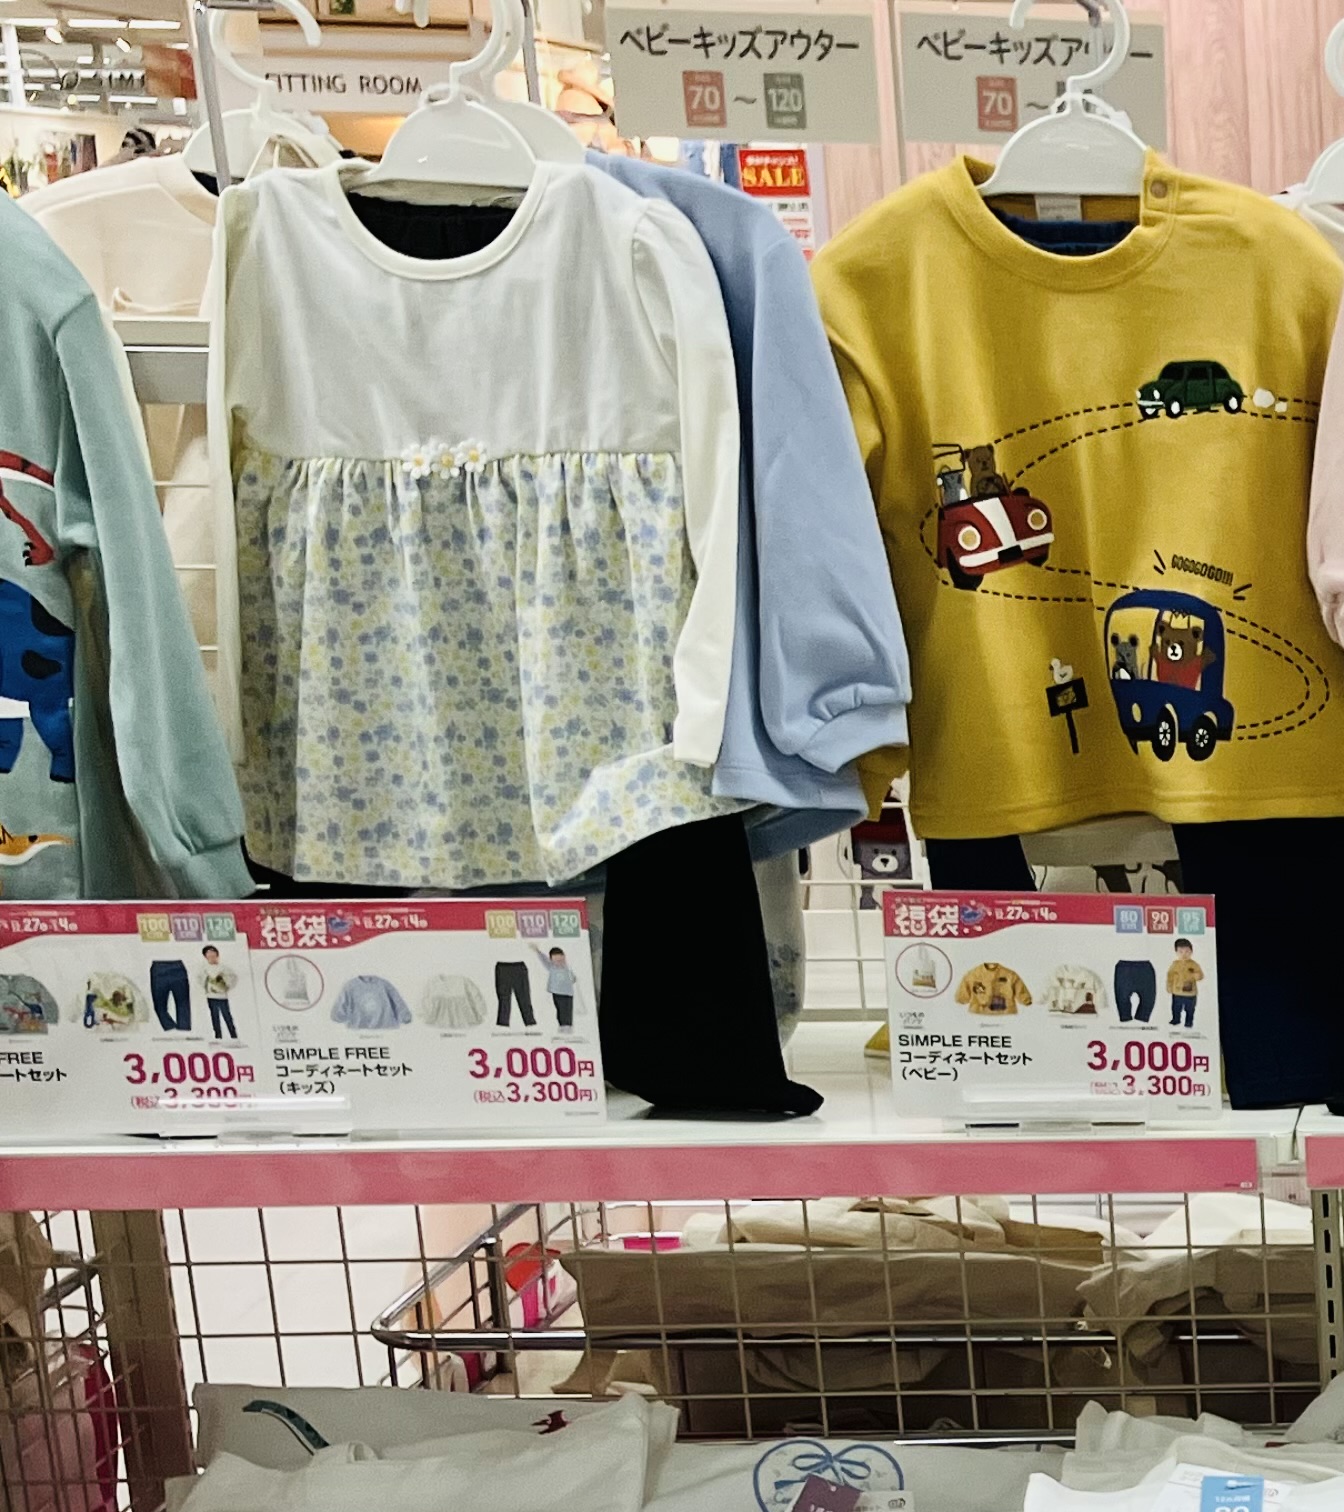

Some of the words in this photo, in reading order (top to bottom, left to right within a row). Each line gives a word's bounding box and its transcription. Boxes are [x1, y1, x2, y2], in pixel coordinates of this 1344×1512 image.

[620, 23, 859, 61] ベビーキッズアウター
[359, 75, 422, 94] ROOM
[689, 86, 720, 110] 70
[768, 89, 802, 112] 120
[982, 90, 1013, 114] 70
[742, 166, 806, 187] SALE
[968, 1035, 1012, 1048] FREE
[346, 1047, 390, 1060] FREE
[468, 1047, 595, 1080] 3,000円
[900, 1051, 1033, 1065] コーディネートセット
[1087, 1040, 1210, 1072] 3,000円
[123, 1052, 255, 1085] 3,000円
[276, 1062, 413, 1077] コーディネートセット
